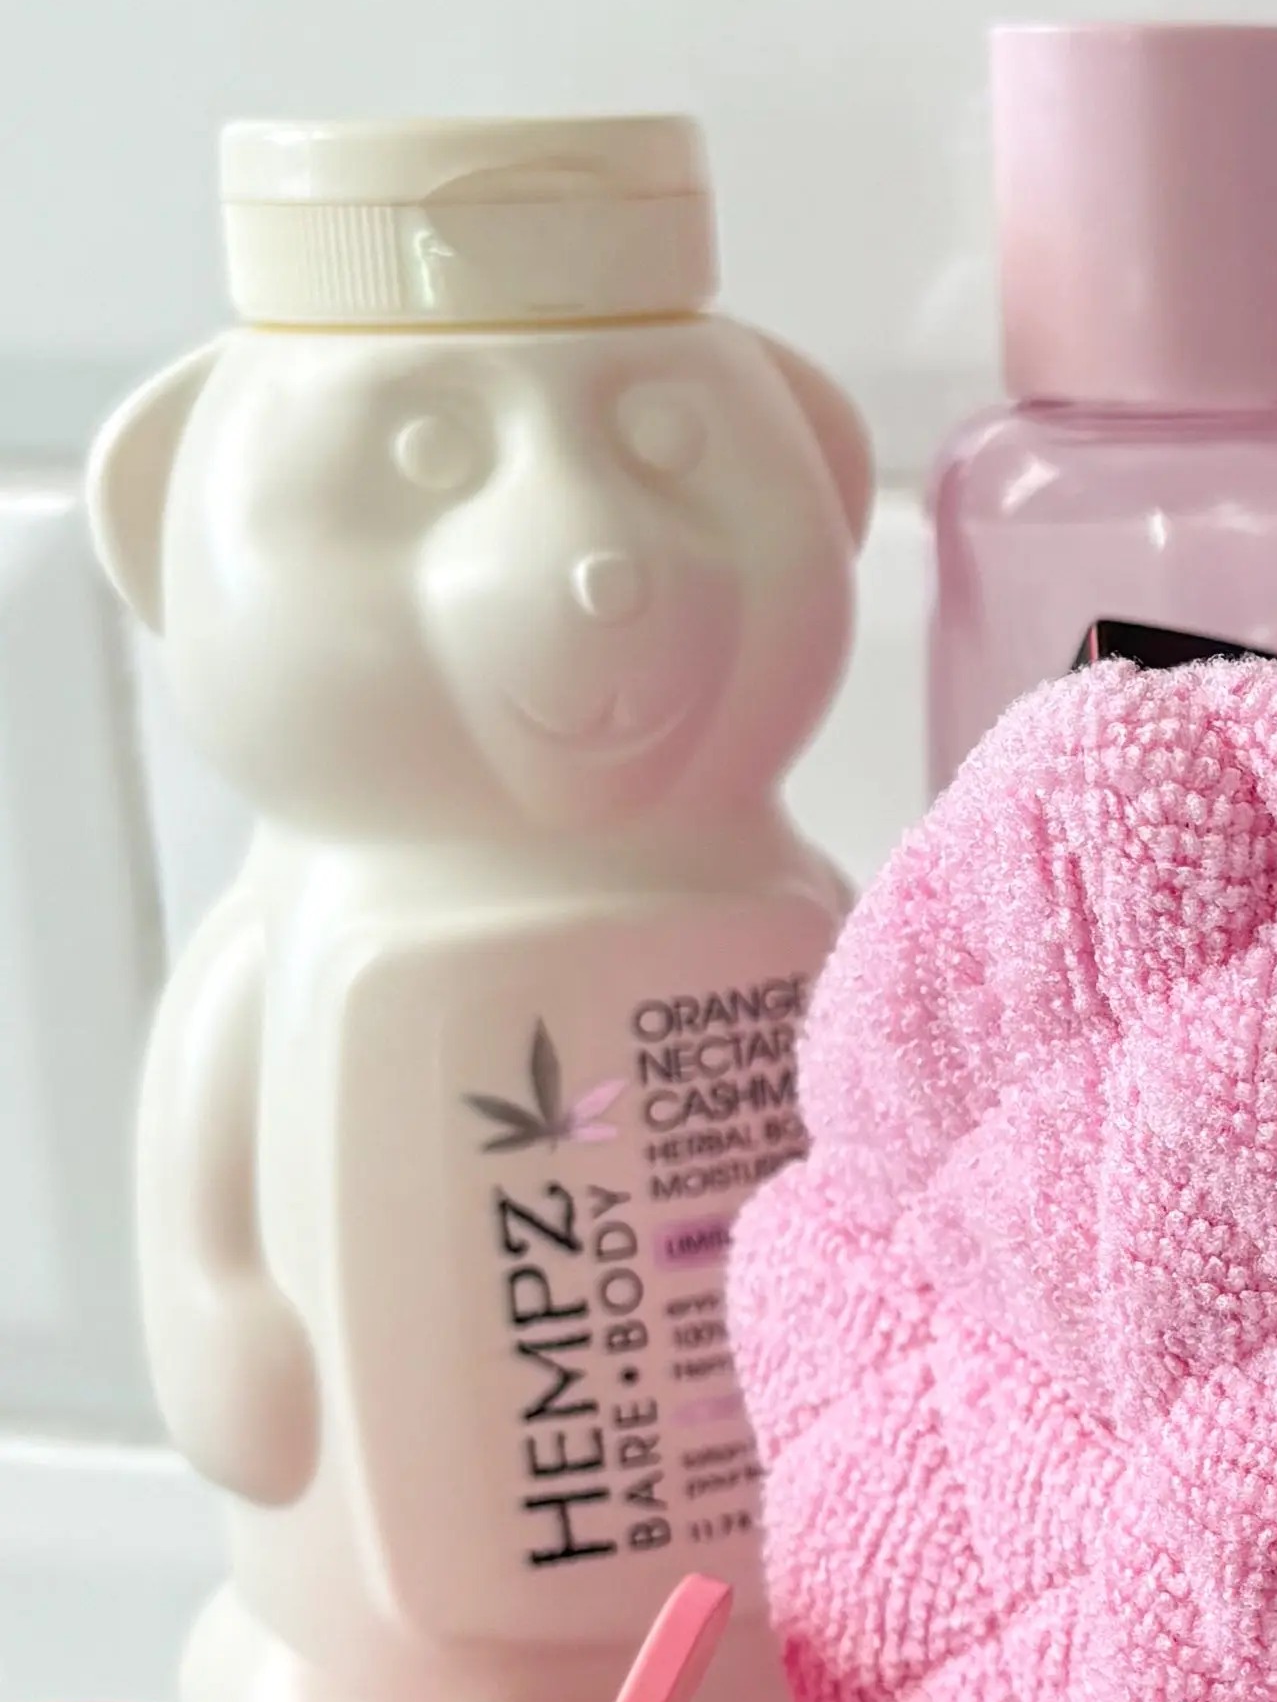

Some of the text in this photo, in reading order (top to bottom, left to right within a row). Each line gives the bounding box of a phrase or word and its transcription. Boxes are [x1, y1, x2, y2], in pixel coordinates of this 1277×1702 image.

[643, 1066, 798, 1134] CASHM
[494, 1180, 617, 1567] HEMPZ
[588, 1183, 673, 1551] BARE BODY
